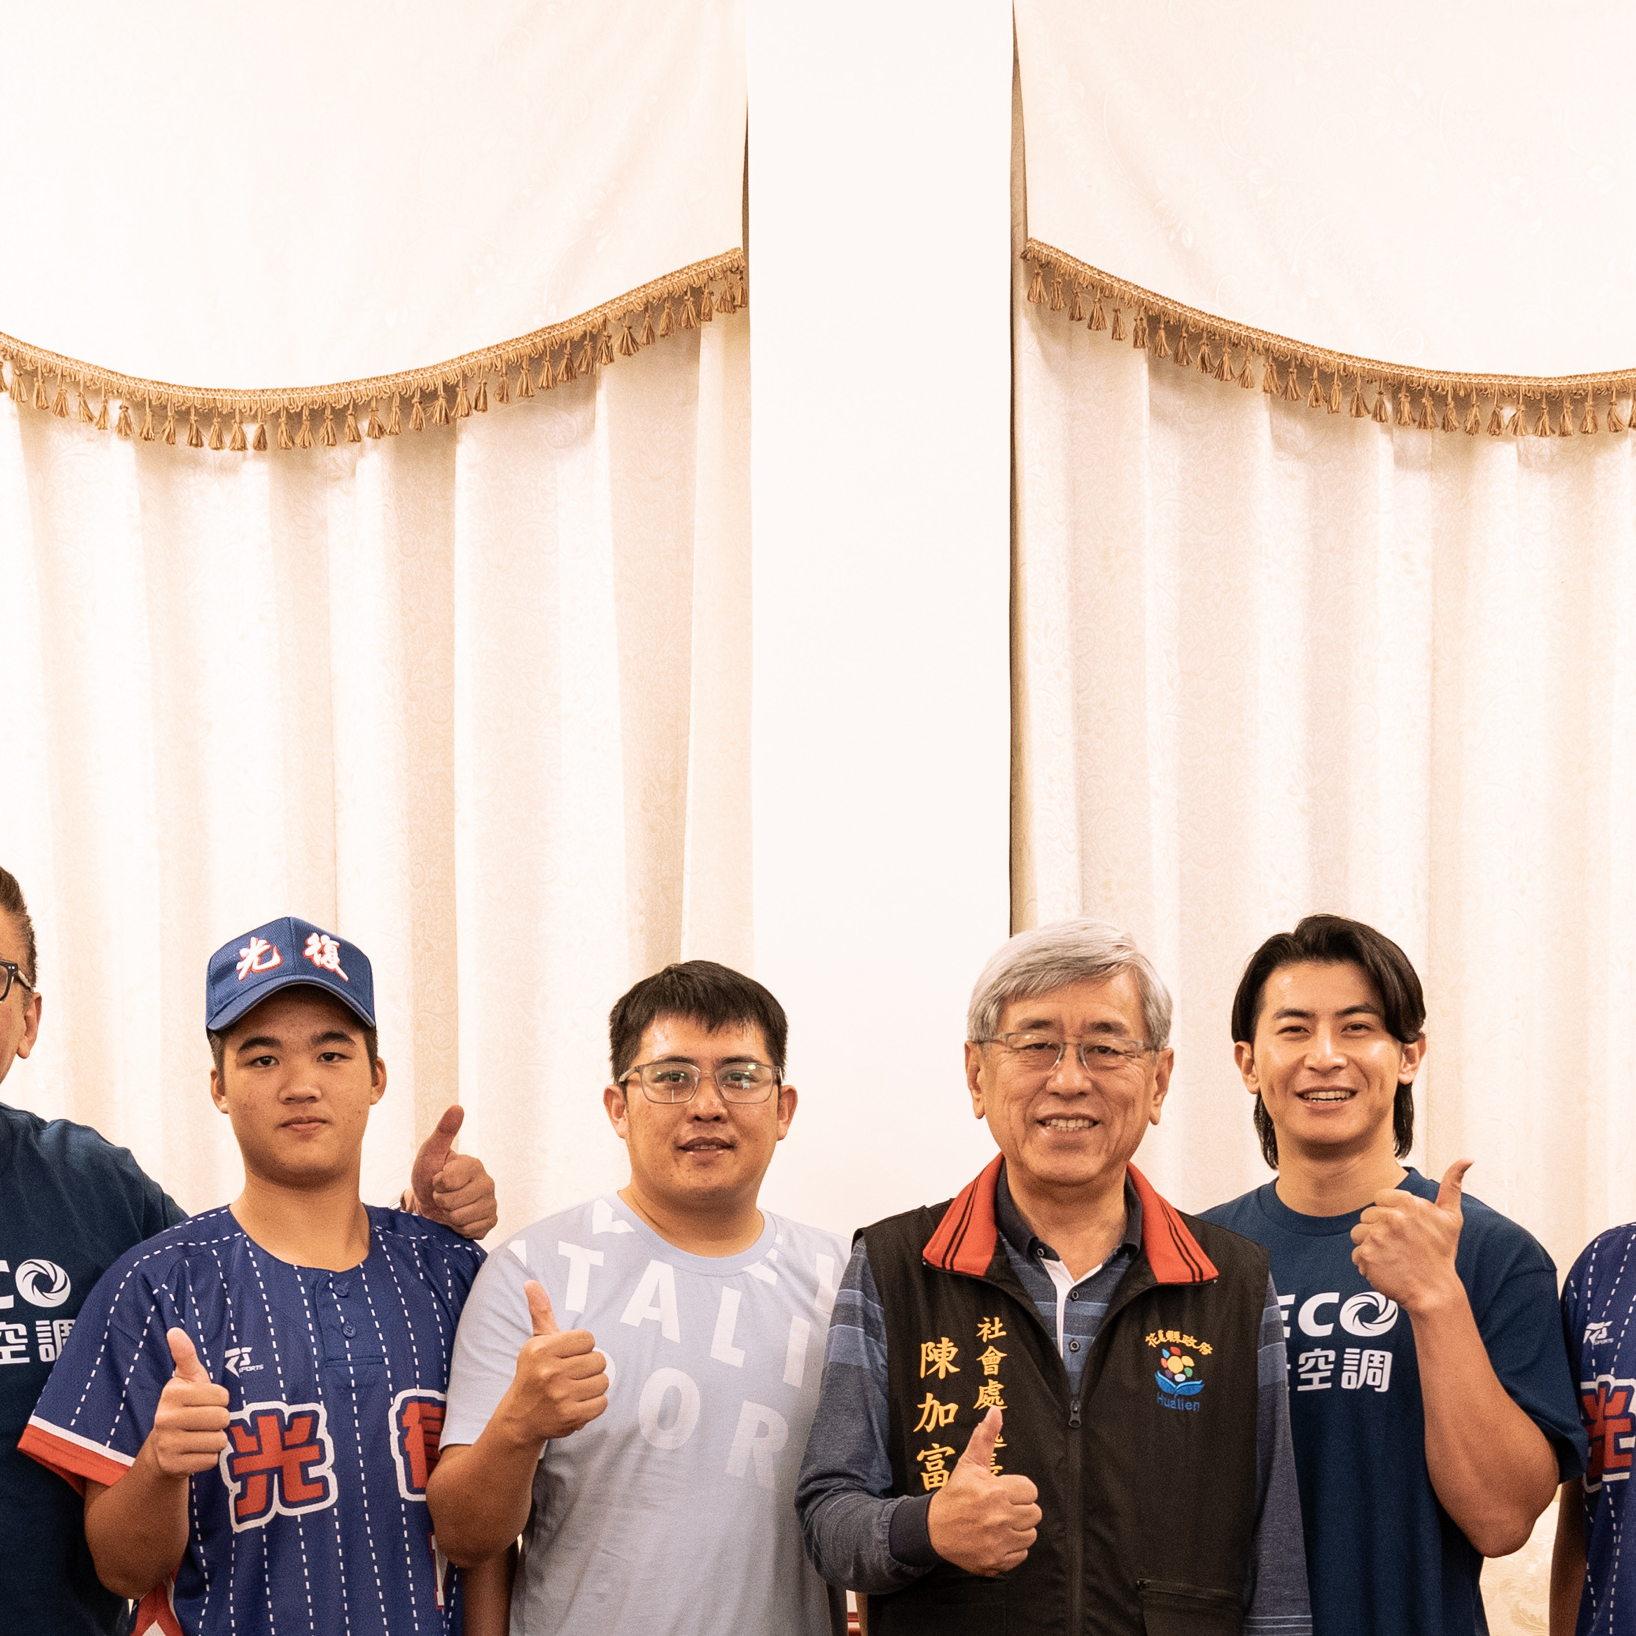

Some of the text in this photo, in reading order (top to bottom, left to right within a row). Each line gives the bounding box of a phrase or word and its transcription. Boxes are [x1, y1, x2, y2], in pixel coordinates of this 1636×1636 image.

[235, 932, 349, 983] 光復
[1287, 1347, 1393, 1393] 空調
[913, 1337, 961, 1491] 陳加富
[1157, 1391, 1200, 1411] Hualien
